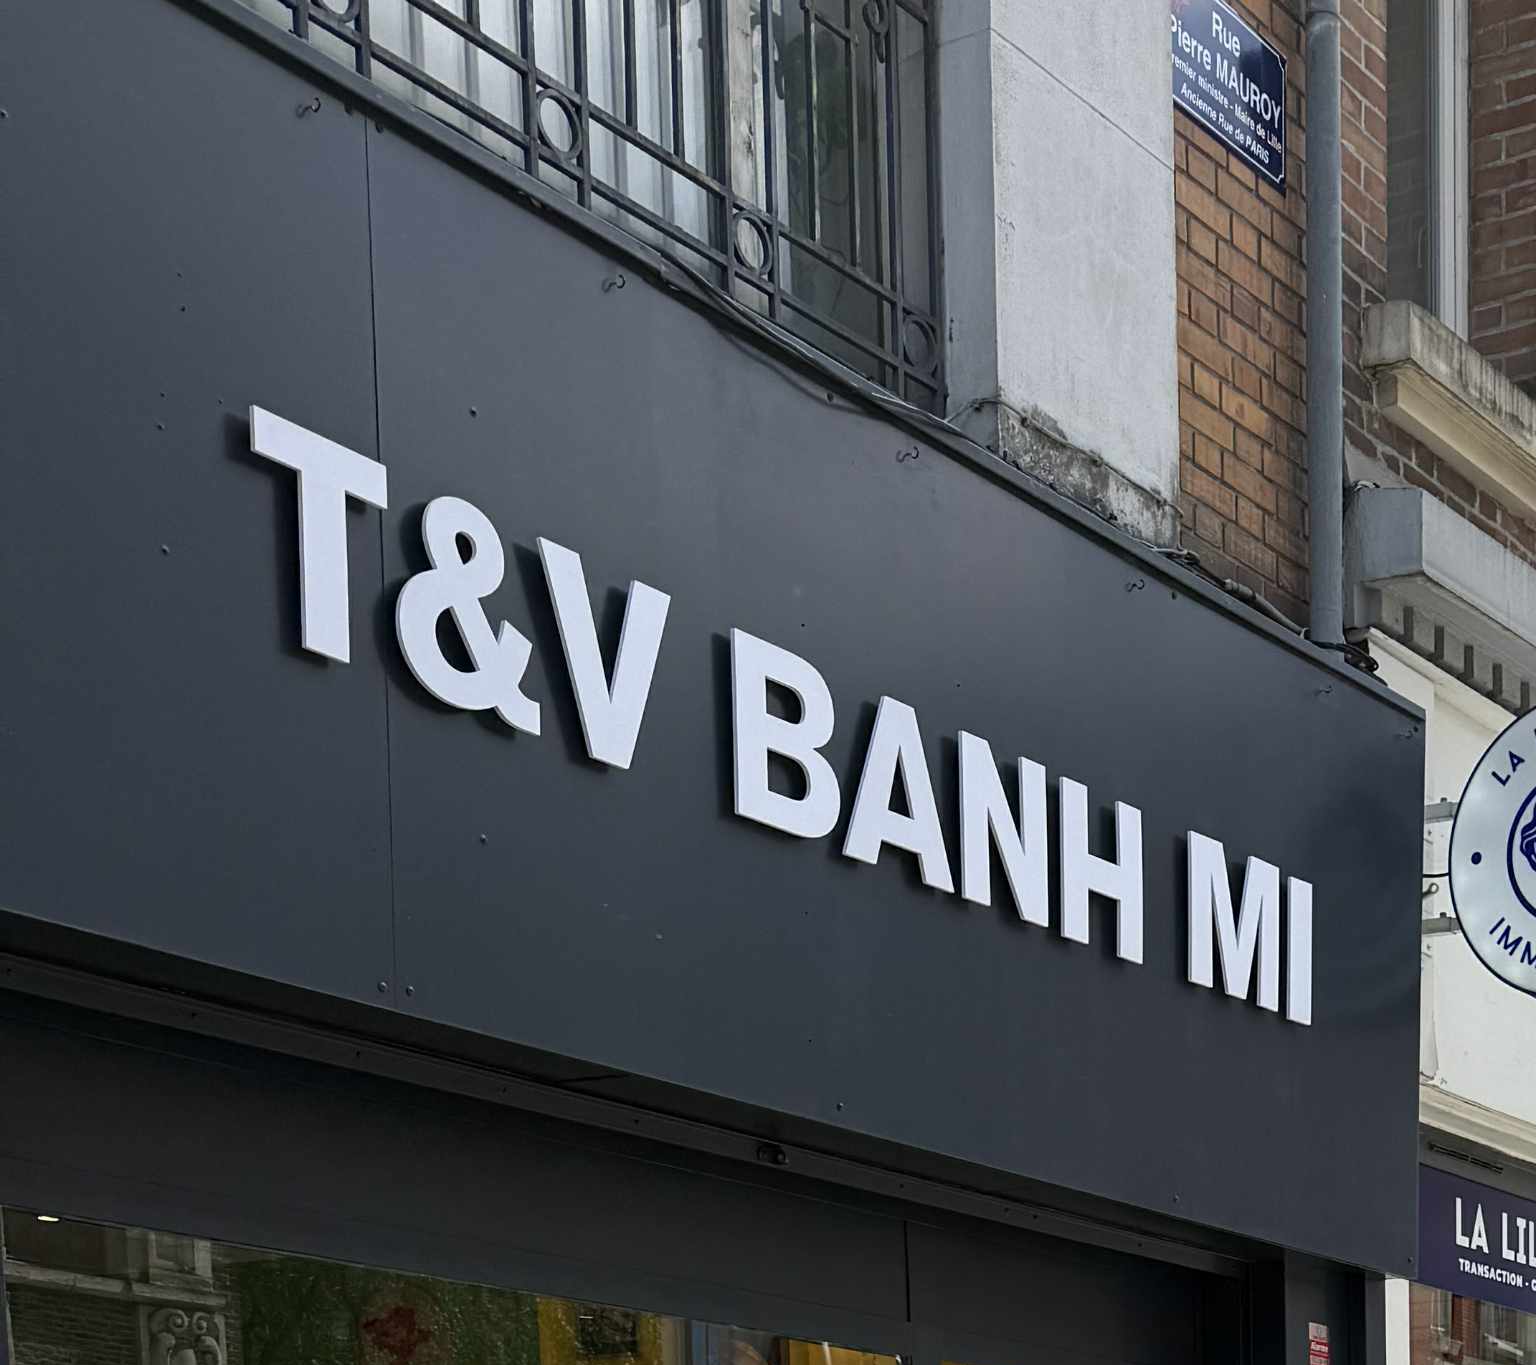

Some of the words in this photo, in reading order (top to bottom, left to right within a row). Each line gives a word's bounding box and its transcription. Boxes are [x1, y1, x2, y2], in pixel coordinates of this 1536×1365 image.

[1212, 11, 1240, 57] Rue
[1172, 53, 1196, 80] remier
[1199, 73, 1228, 109] ministre
[1235, 104, 1255, 131] Maire
[1256, 122, 1266, 140] de
[1267, 131, 1282, 153] Lille
[1180, 83, 1217, 121] Ancienne
[1218, 113, 1234, 136] Rue
[1235, 128, 1245, 144] de
[1246, 136, 1270, 164] PARIS
[1216, 53, 1281, 129] MAUROY
[250, 404, 671, 769] T&V
[730, 627, 1144, 965] BANH
[1187, 829, 1313, 1026] MI
[1491, 750, 1525, 787] LA
[1455, 1197, 1489, 1254] LA
[1458, 1257, 1523, 1288] TRANSACTION
